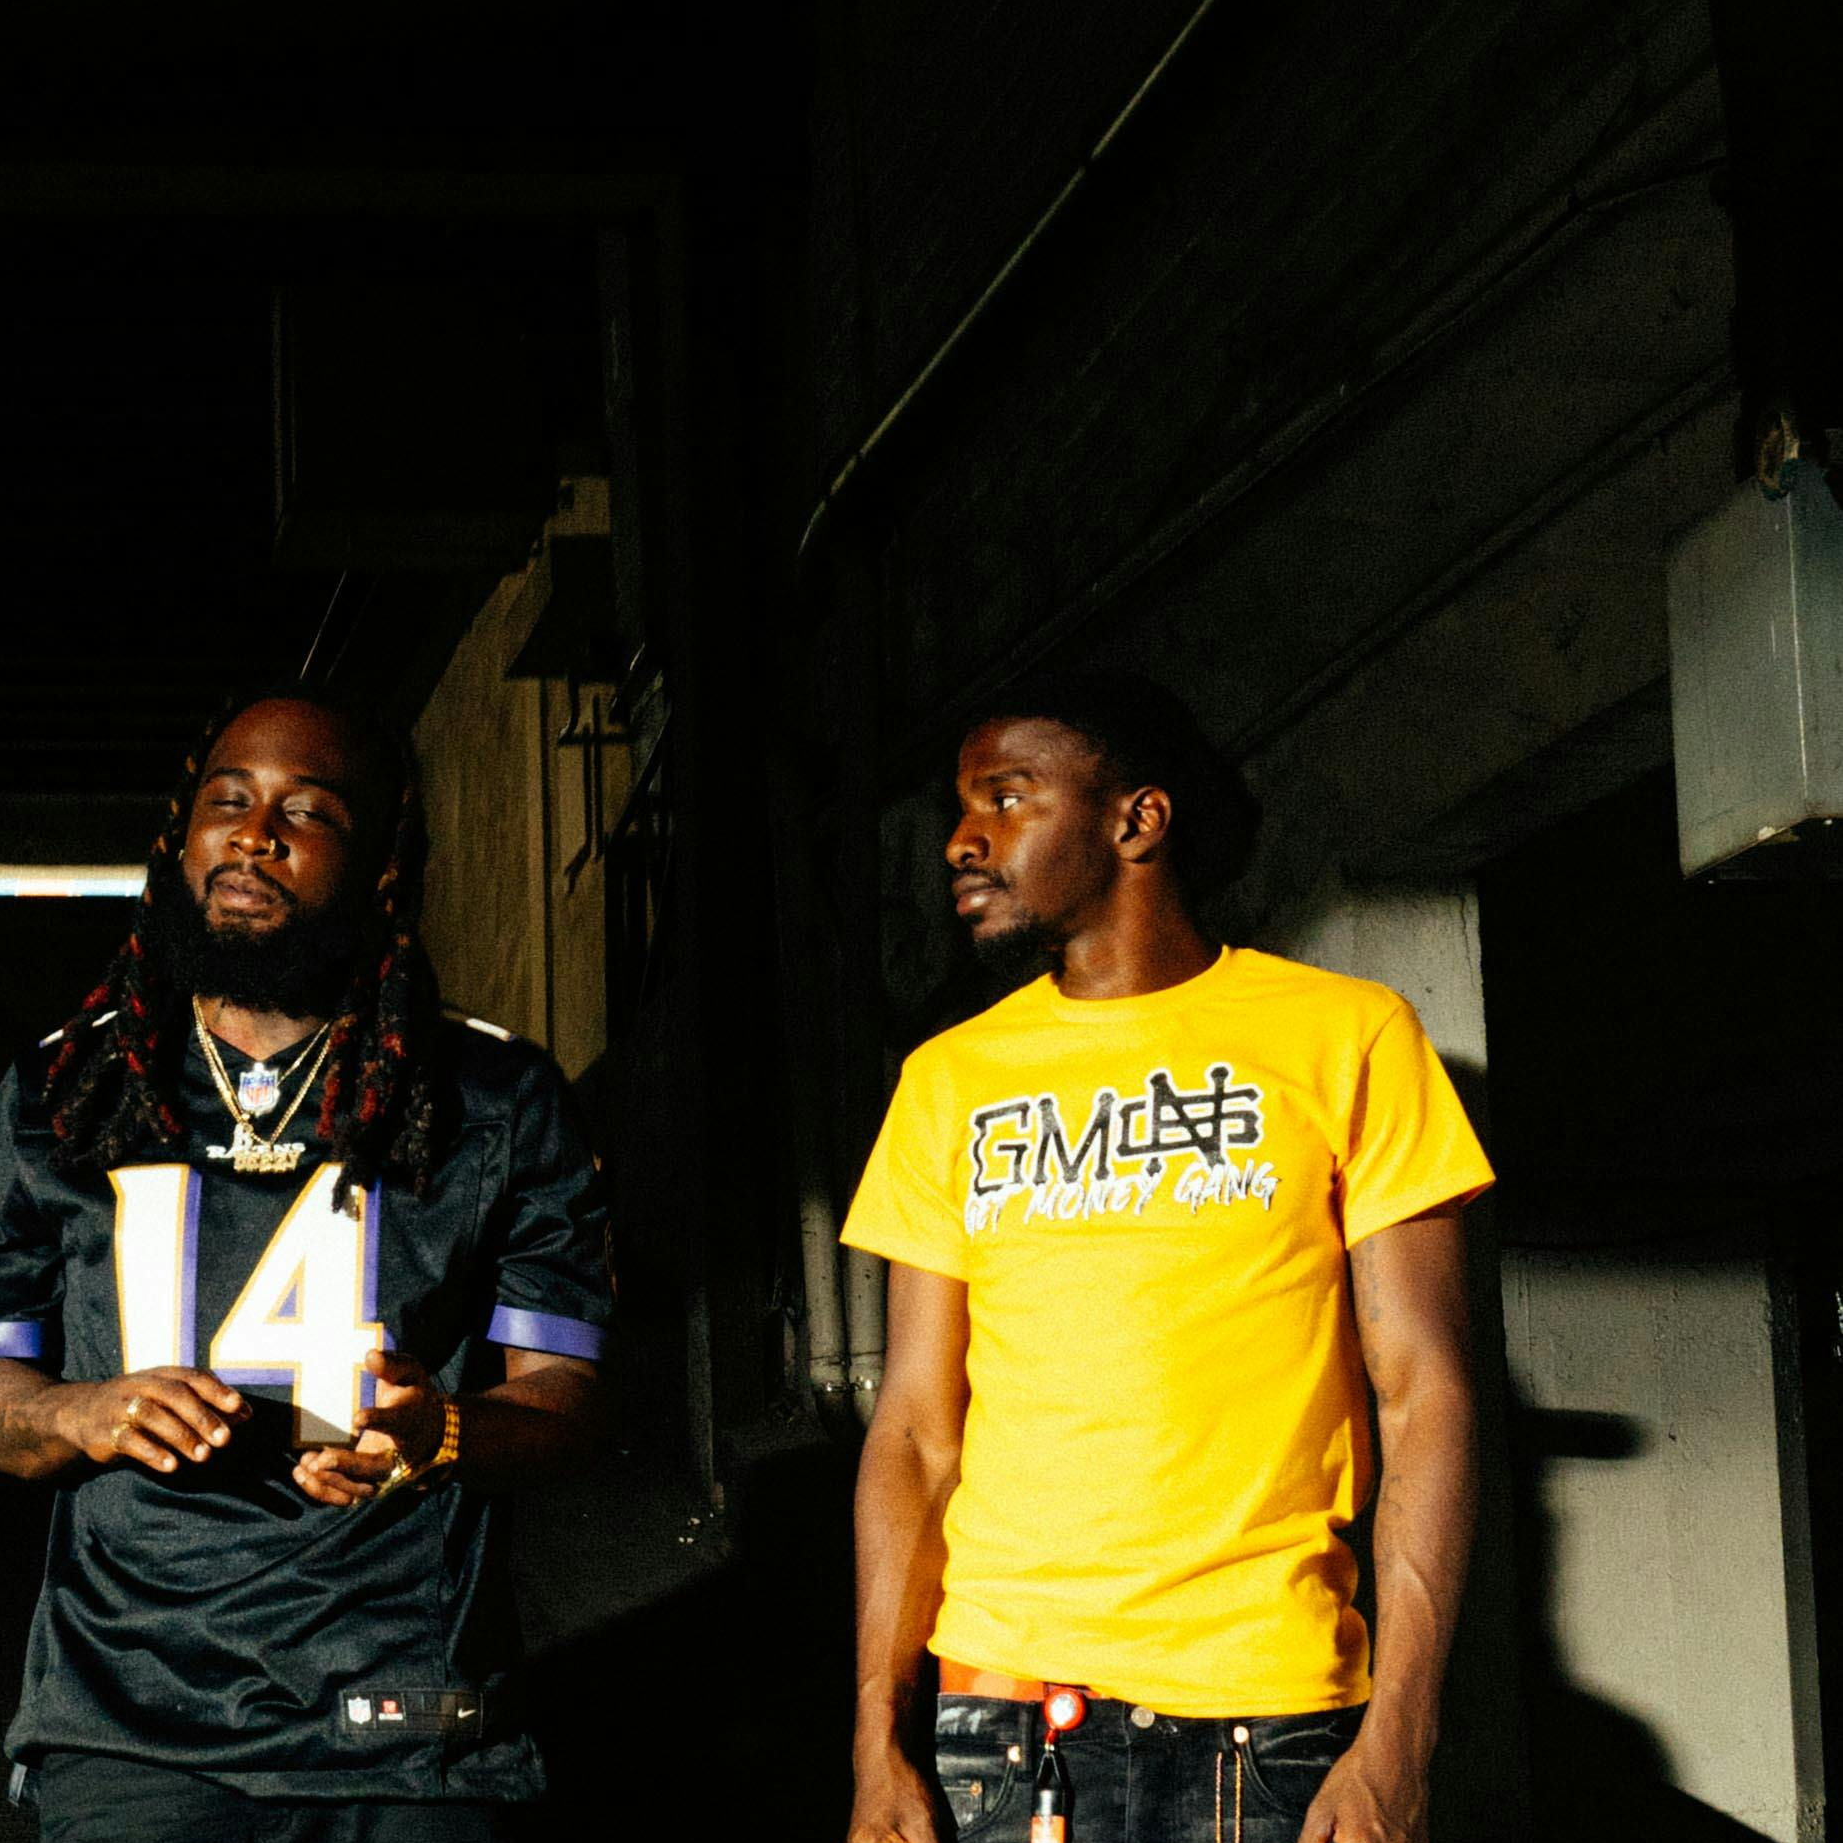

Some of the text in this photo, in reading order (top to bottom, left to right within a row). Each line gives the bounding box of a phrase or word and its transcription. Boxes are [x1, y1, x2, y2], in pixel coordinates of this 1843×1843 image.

[964, 1159, 1281, 1237] GET MONEY GANG
[107, 1163, 395, 1449] 14
